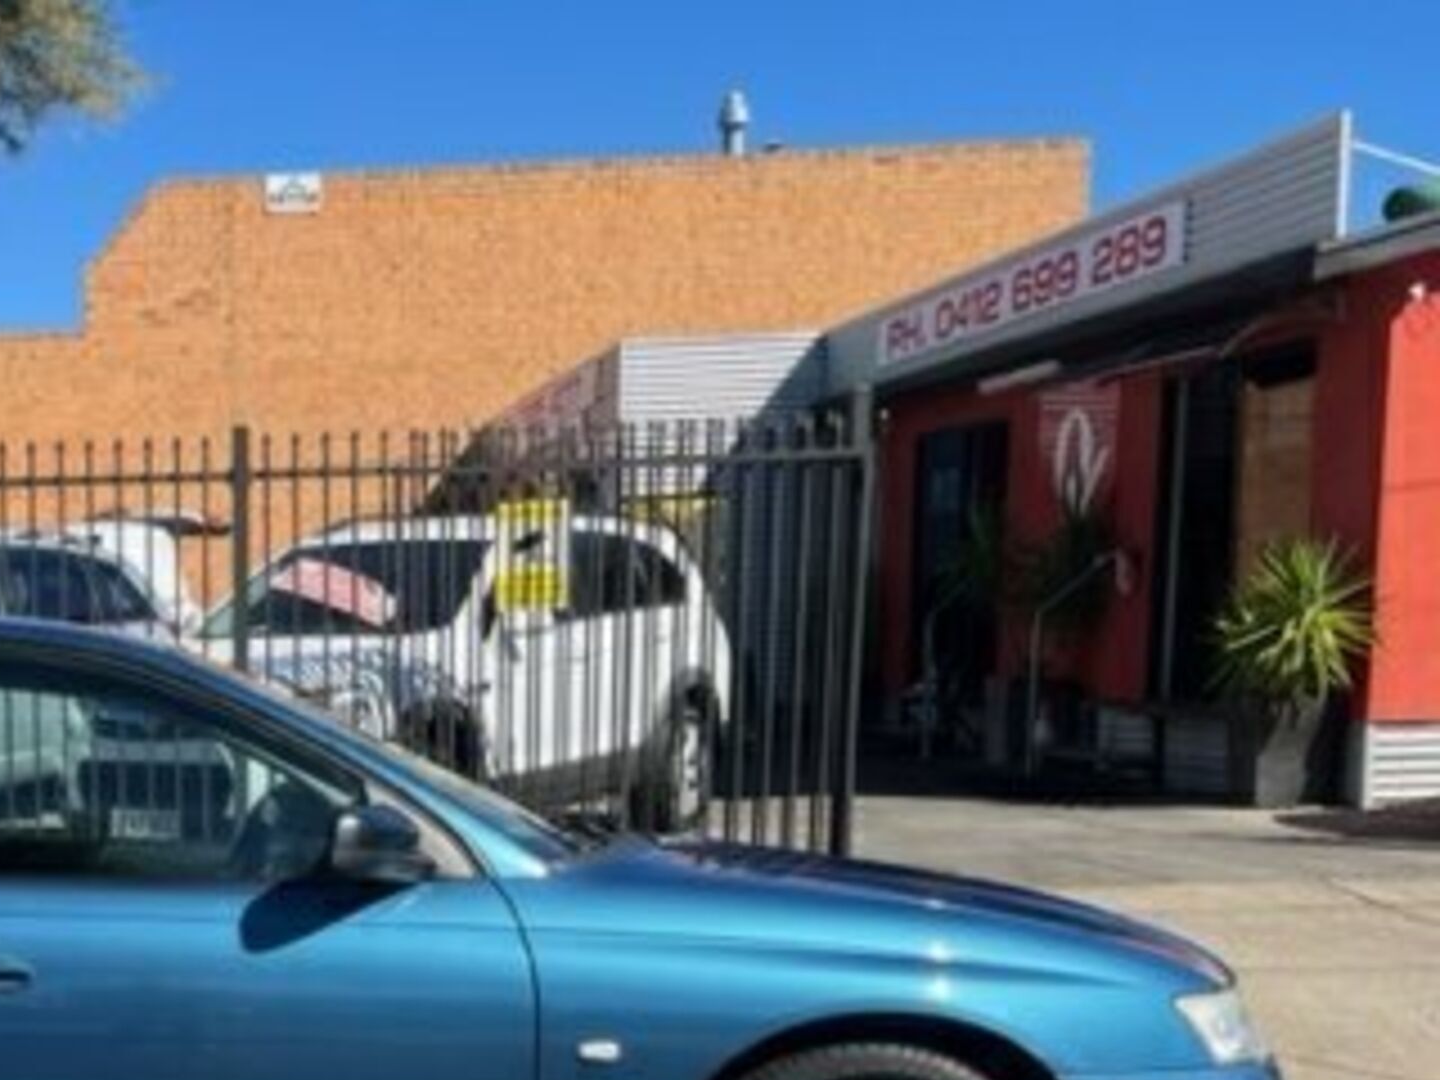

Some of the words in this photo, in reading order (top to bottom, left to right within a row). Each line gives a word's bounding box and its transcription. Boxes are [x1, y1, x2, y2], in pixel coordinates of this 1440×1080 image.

[934, 280, 1003, 339] 0412
[1012, 250, 1078, 311] 699
[1091, 215, 1167, 285] 289
